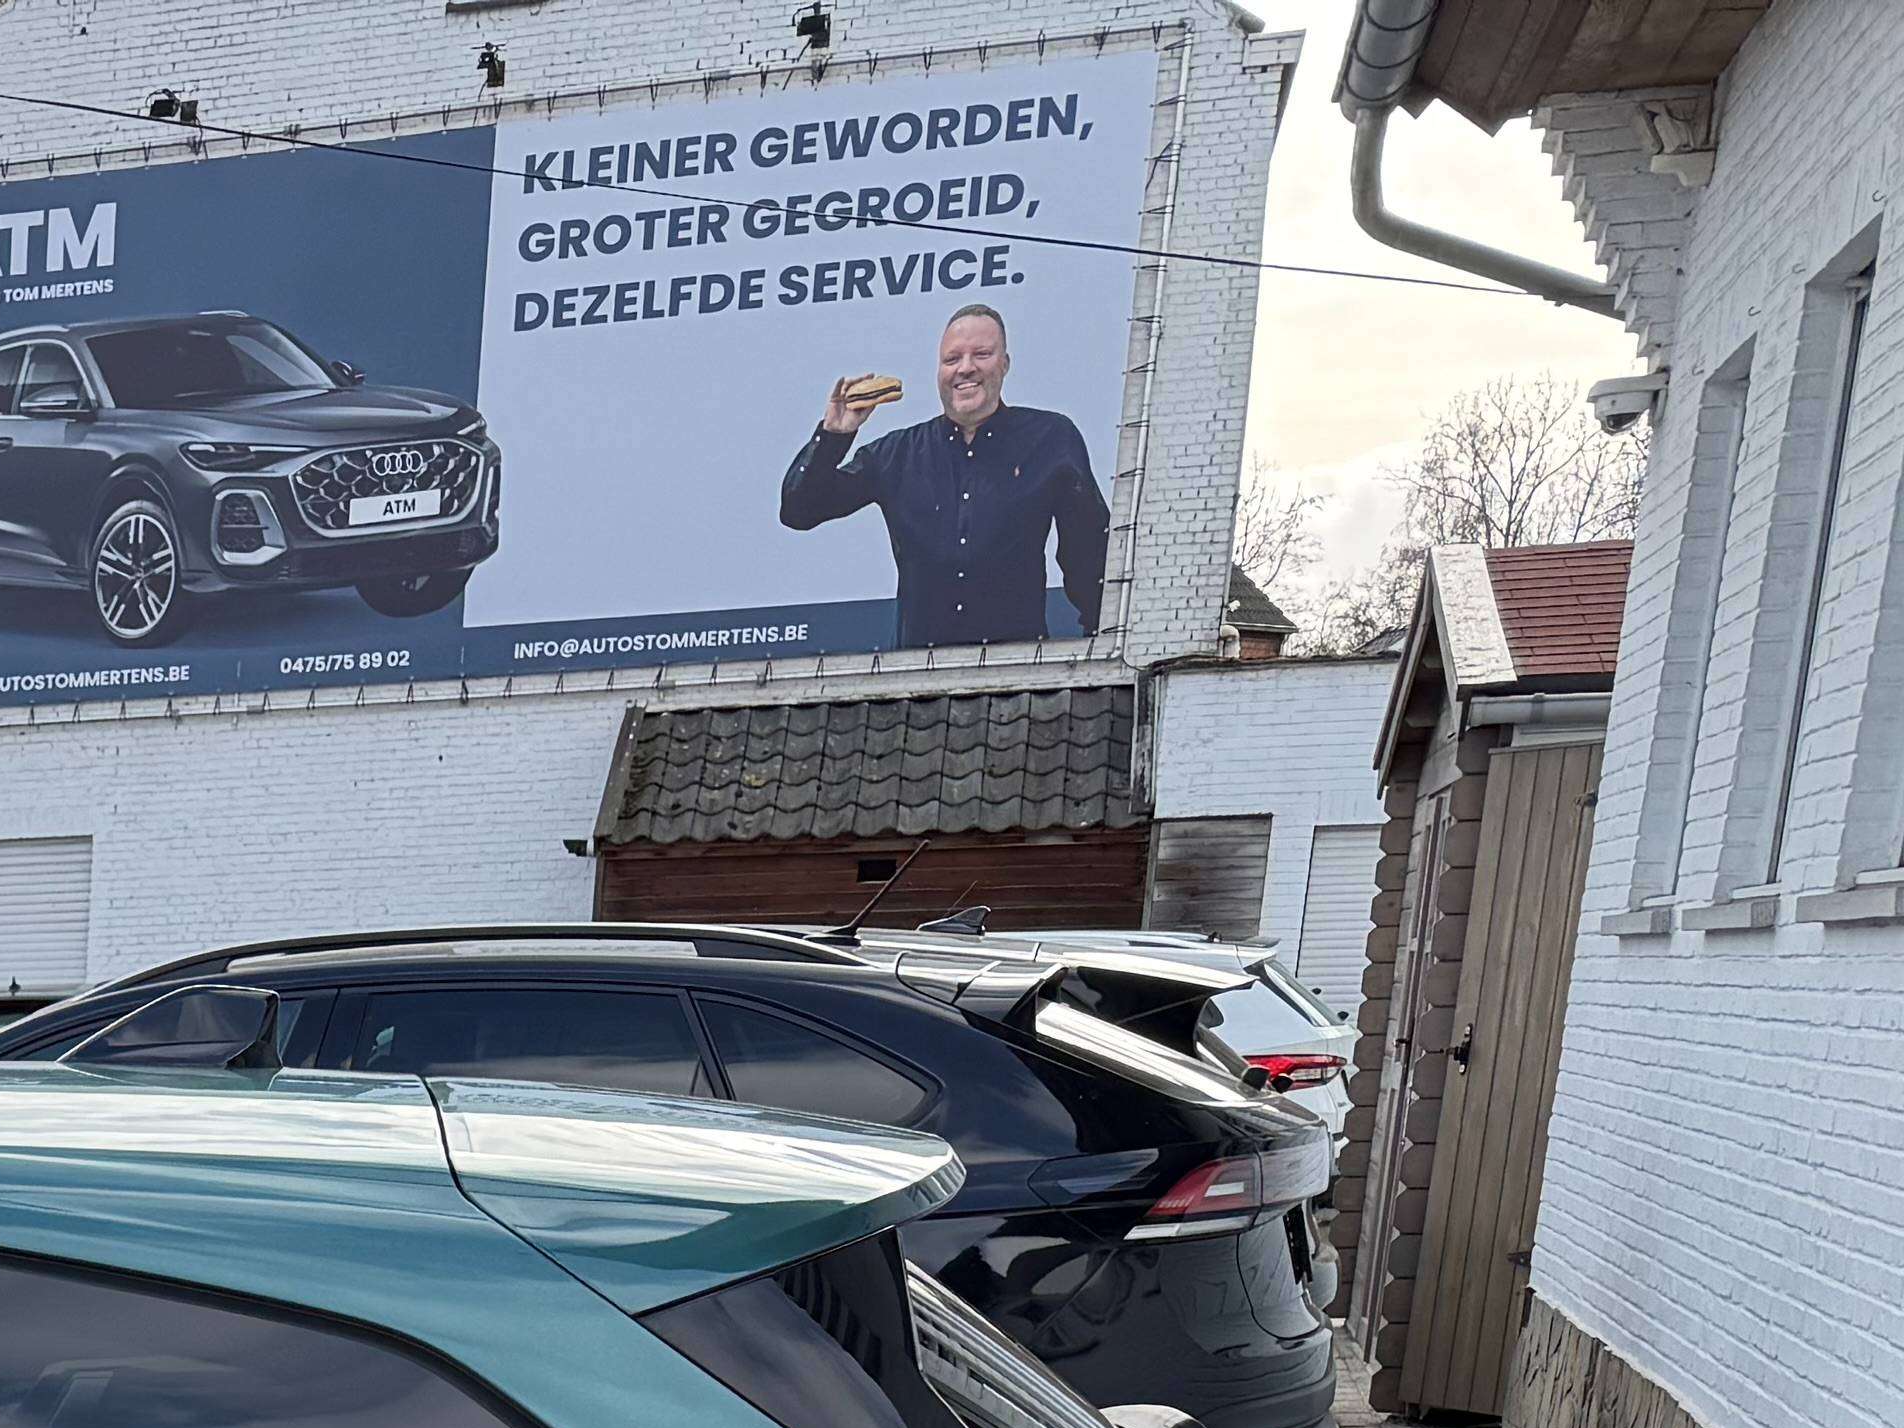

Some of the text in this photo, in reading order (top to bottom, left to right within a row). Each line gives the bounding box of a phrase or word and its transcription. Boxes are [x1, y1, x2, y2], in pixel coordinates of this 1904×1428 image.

[523, 93, 1094, 194] KLEINER GEWORDEN,
[518, 173, 1040, 263] GROTER GEGROEID,
[3, 286, 39, 302] TOM
[41, 279, 114, 299] MERTENS
[513, 244, 1025, 332] DEZELFDE SERVICE.
[383, 498, 416, 516] ATM
[514, 623, 808, 659] INFO@AUTOSTOMMERTENS.BE
[279, 649, 410, 674] 0475/75 89 02
